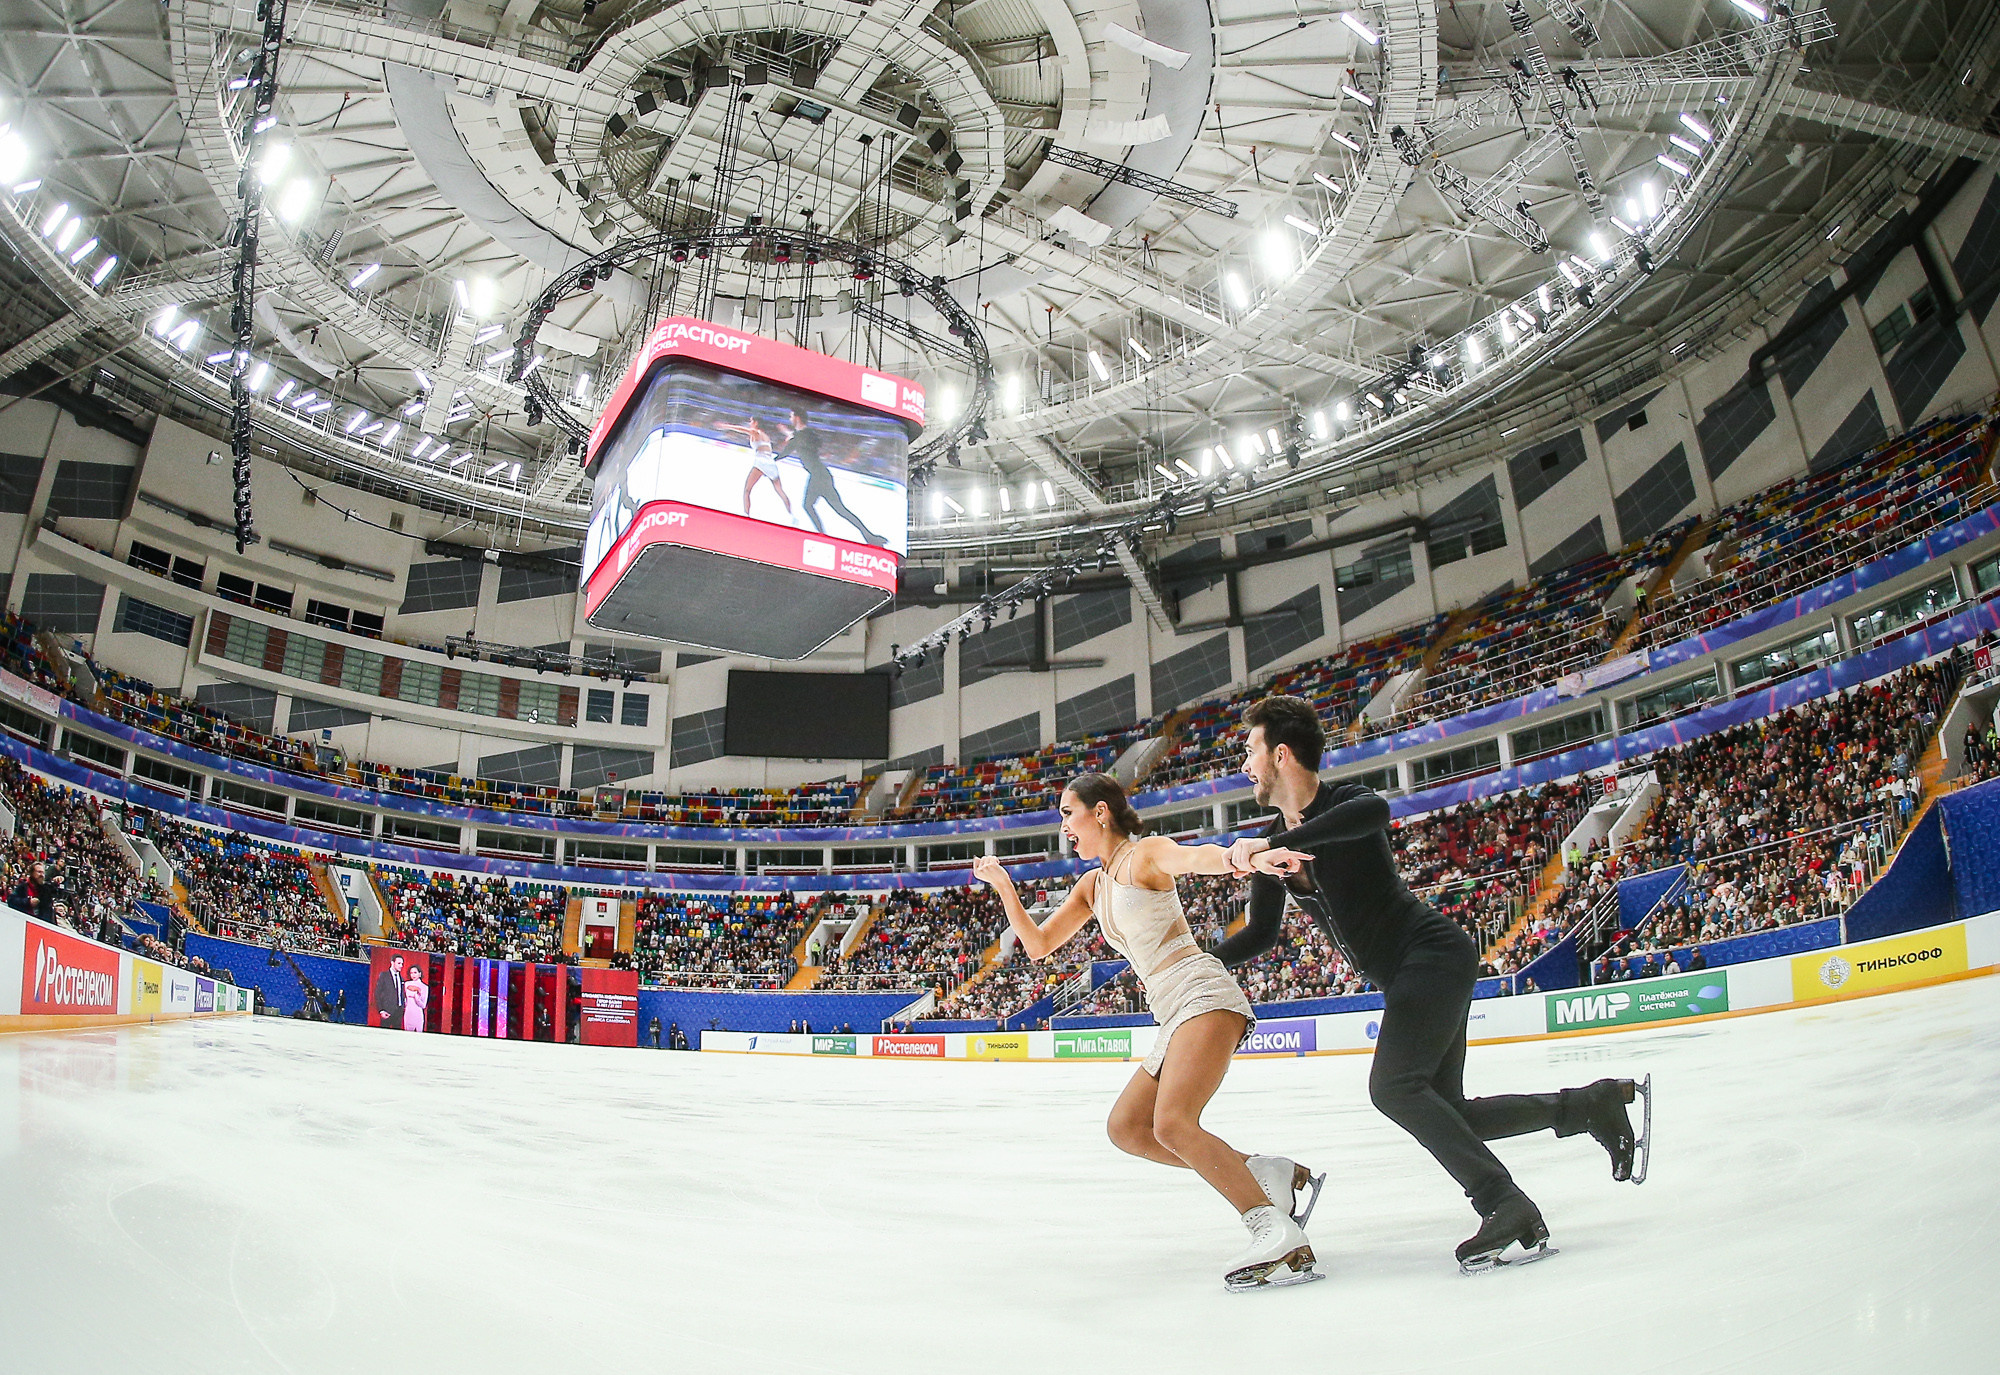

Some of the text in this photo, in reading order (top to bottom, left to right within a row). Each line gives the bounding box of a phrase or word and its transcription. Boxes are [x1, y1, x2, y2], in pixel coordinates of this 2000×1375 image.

[1605, 781, 1615, 792] C3
[1856, 947, 1943, 973] ТИНЬКОФФ
[44, 946, 113, 1007] Ростелеком
[1638, 989, 1689, 1003] Платёжная
[1555, 992, 1631, 1024] МИР
[1639, 1000, 1676, 1012] система
[814, 1038, 834, 1051] МИР
[884, 1039, 938, 1055] Ростелеком
[1240, 1031, 1300, 1050] леком
